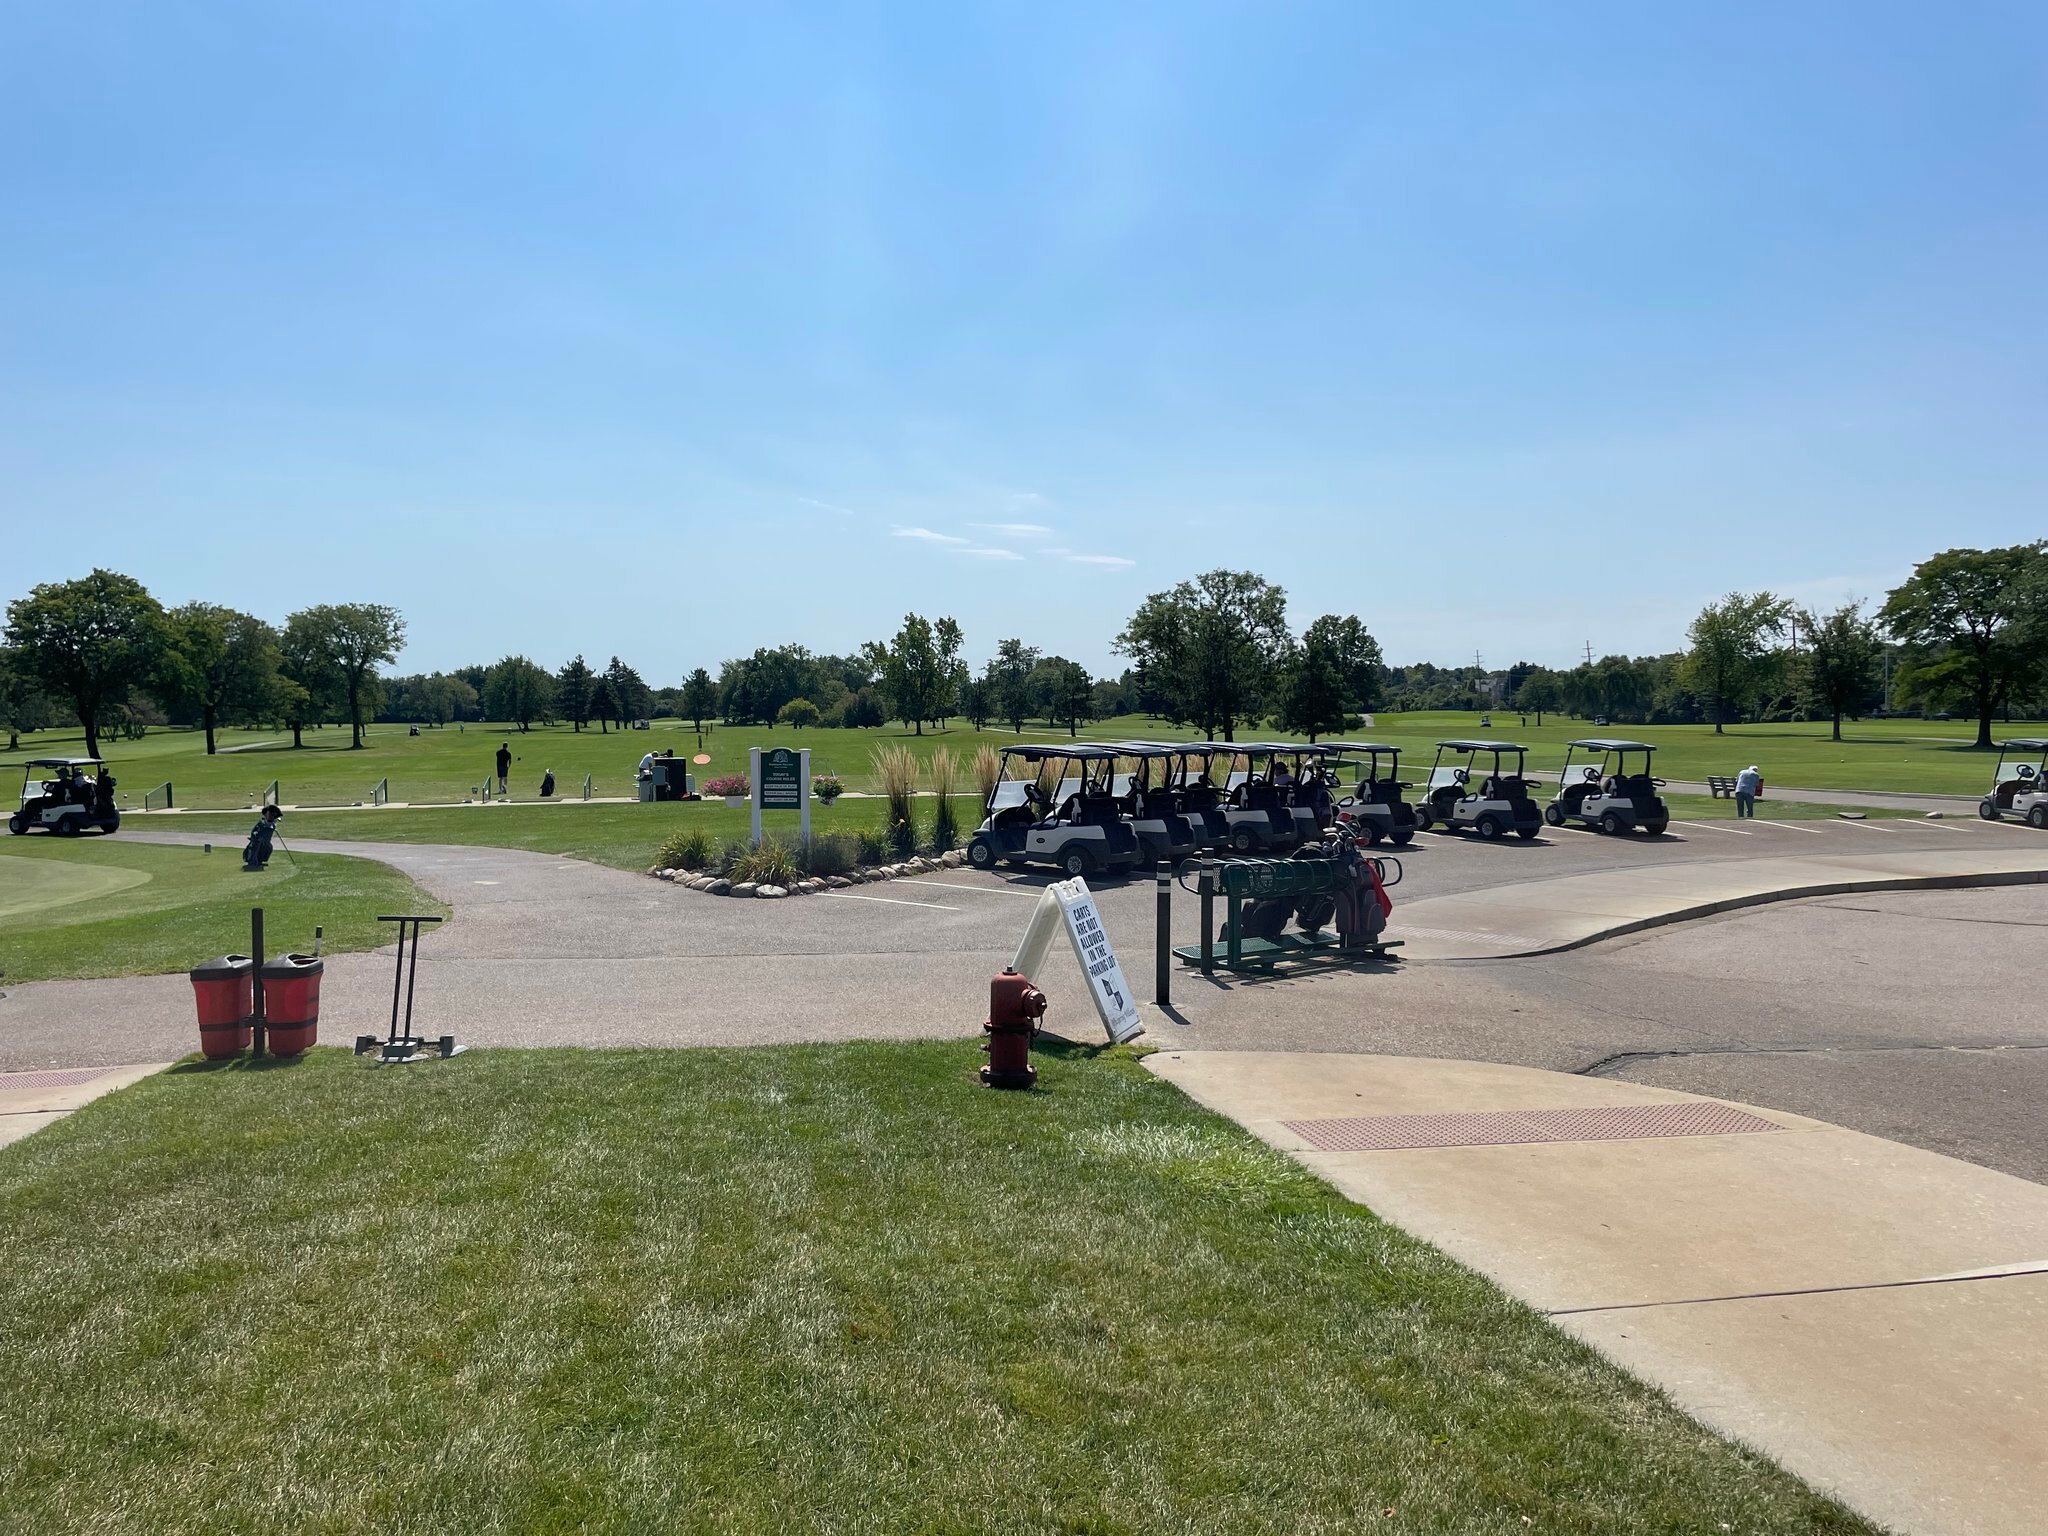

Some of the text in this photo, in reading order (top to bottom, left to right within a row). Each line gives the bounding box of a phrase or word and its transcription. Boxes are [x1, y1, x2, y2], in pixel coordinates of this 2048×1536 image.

[1073, 905, 1091, 921] CARTS
[1075, 917, 1098, 936] ARE NOT
[1080, 930, 1105, 950] ALLOWED
[1087, 944, 1107, 962] IN THE
[1089, 955, 1116, 978] PARKING LOT
